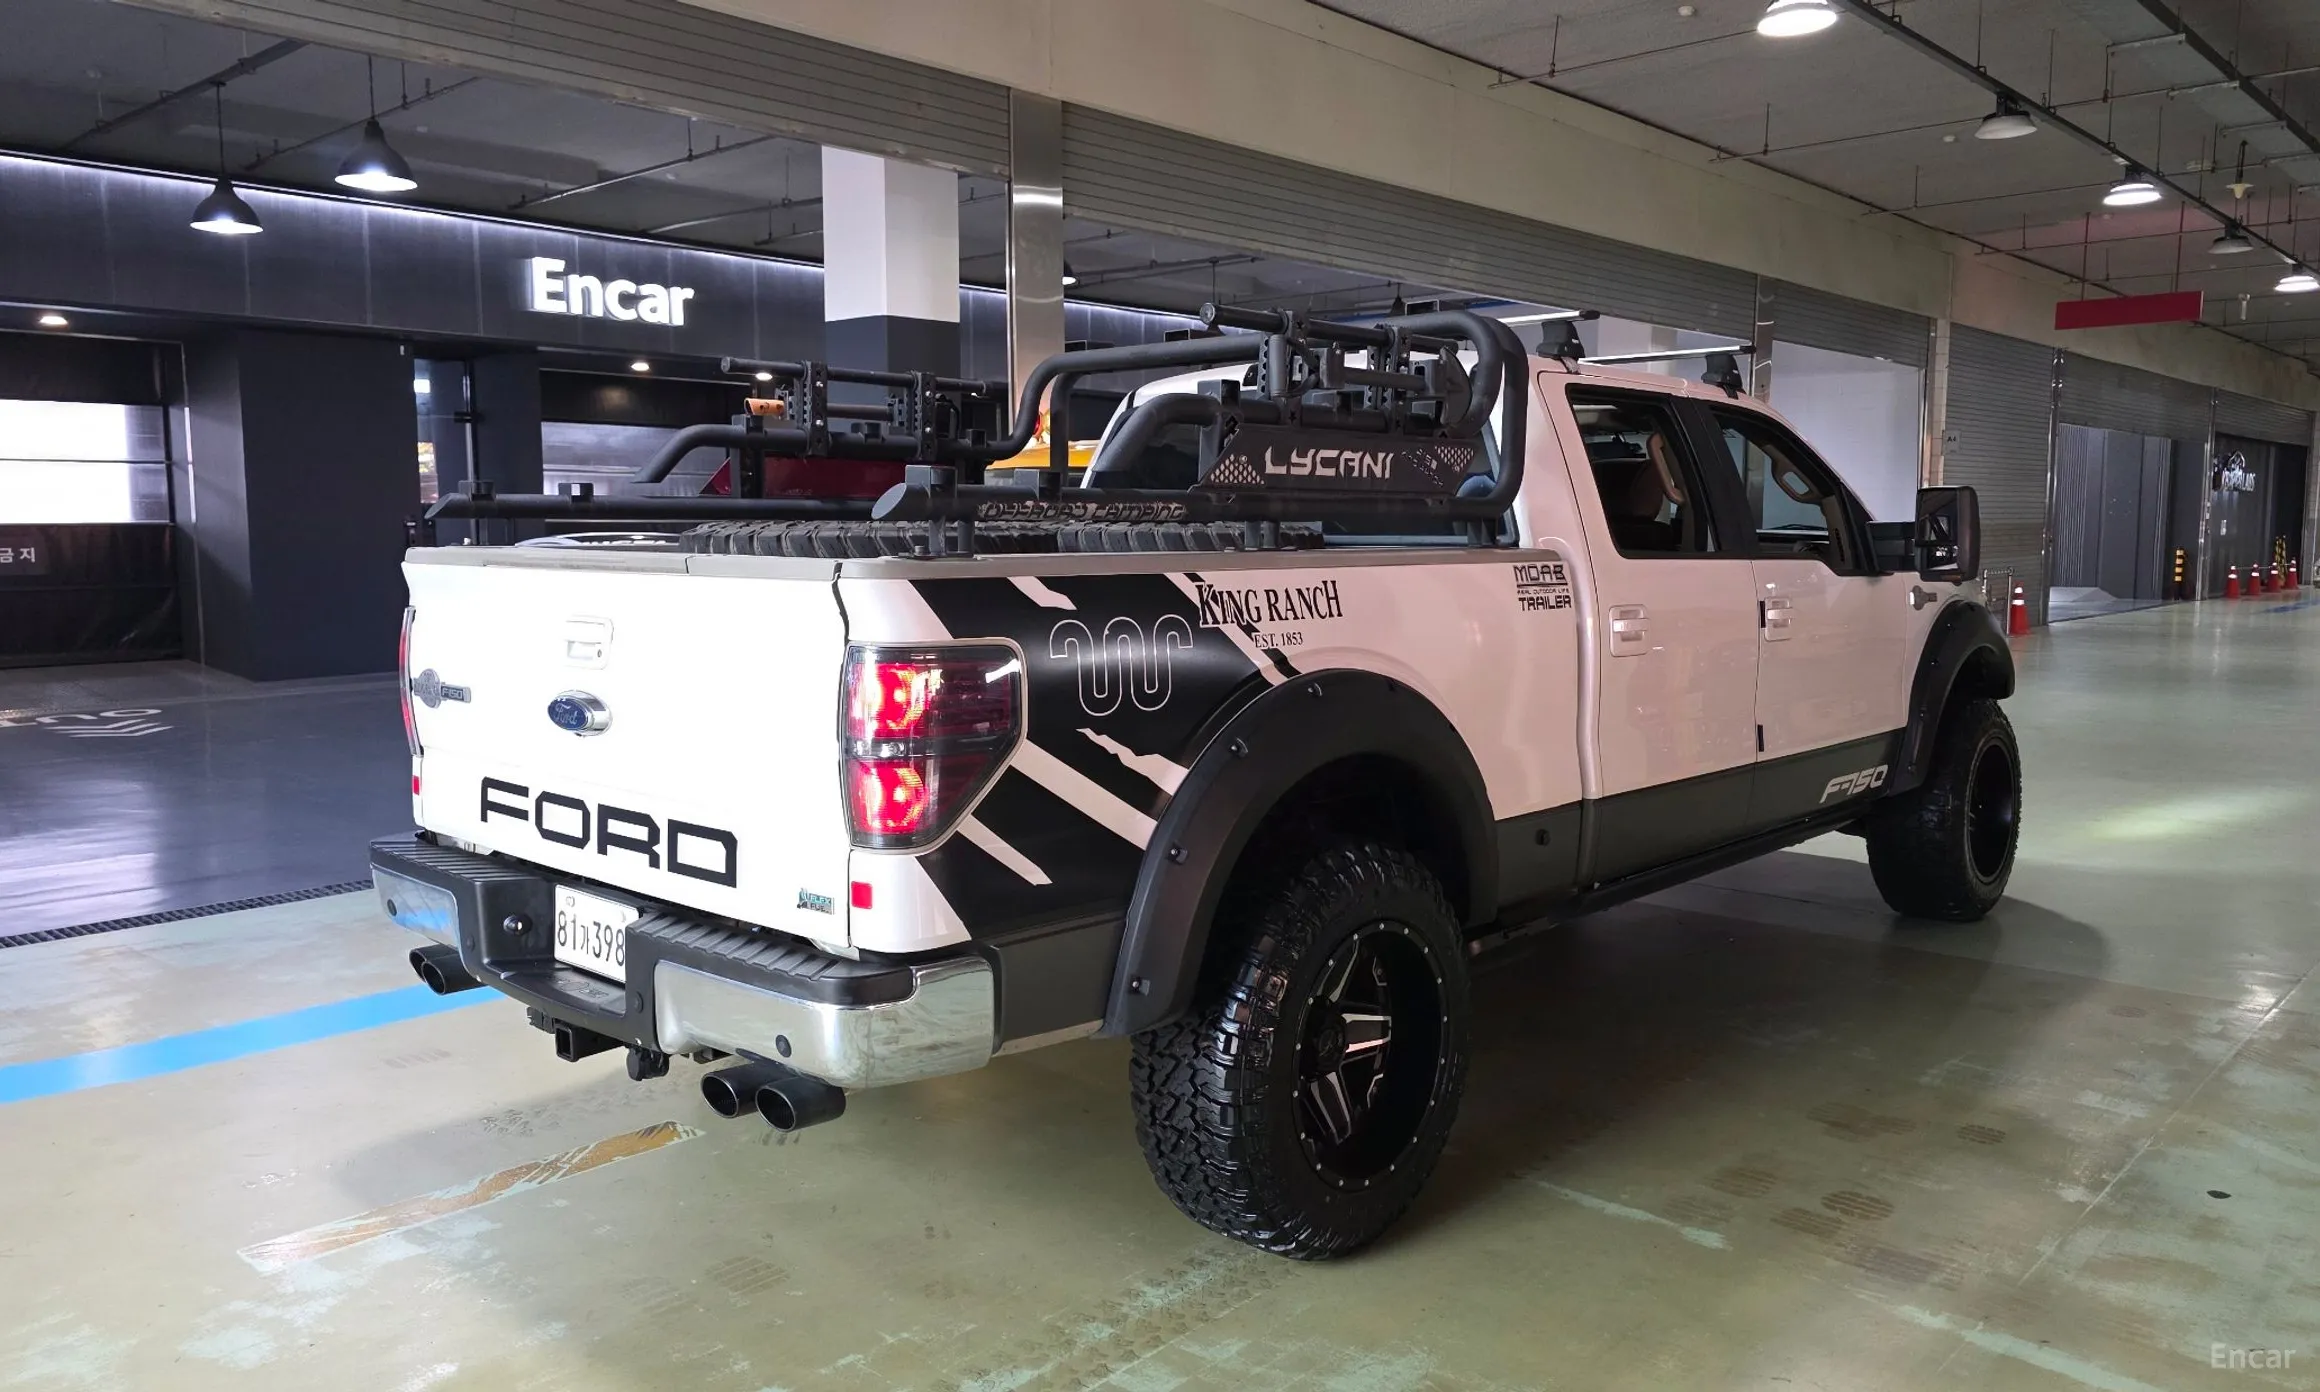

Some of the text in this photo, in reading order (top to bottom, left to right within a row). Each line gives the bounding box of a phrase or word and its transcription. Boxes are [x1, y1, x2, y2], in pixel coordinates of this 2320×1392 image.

[529, 256, 695, 326] Encar
[1265, 446, 1394, 479] LYCANI
[1513, 564, 1567, 582] MOAB
[1195, 580, 1344, 626] KING RANCH
[1518, 595, 1572, 611] TRAILER
[1254, 631, 1304, 648] EST. 1853
[554, 702, 579, 725] Ford
[481, 776, 738, 888] FORD
[557, 909, 626, 967] 81가398
